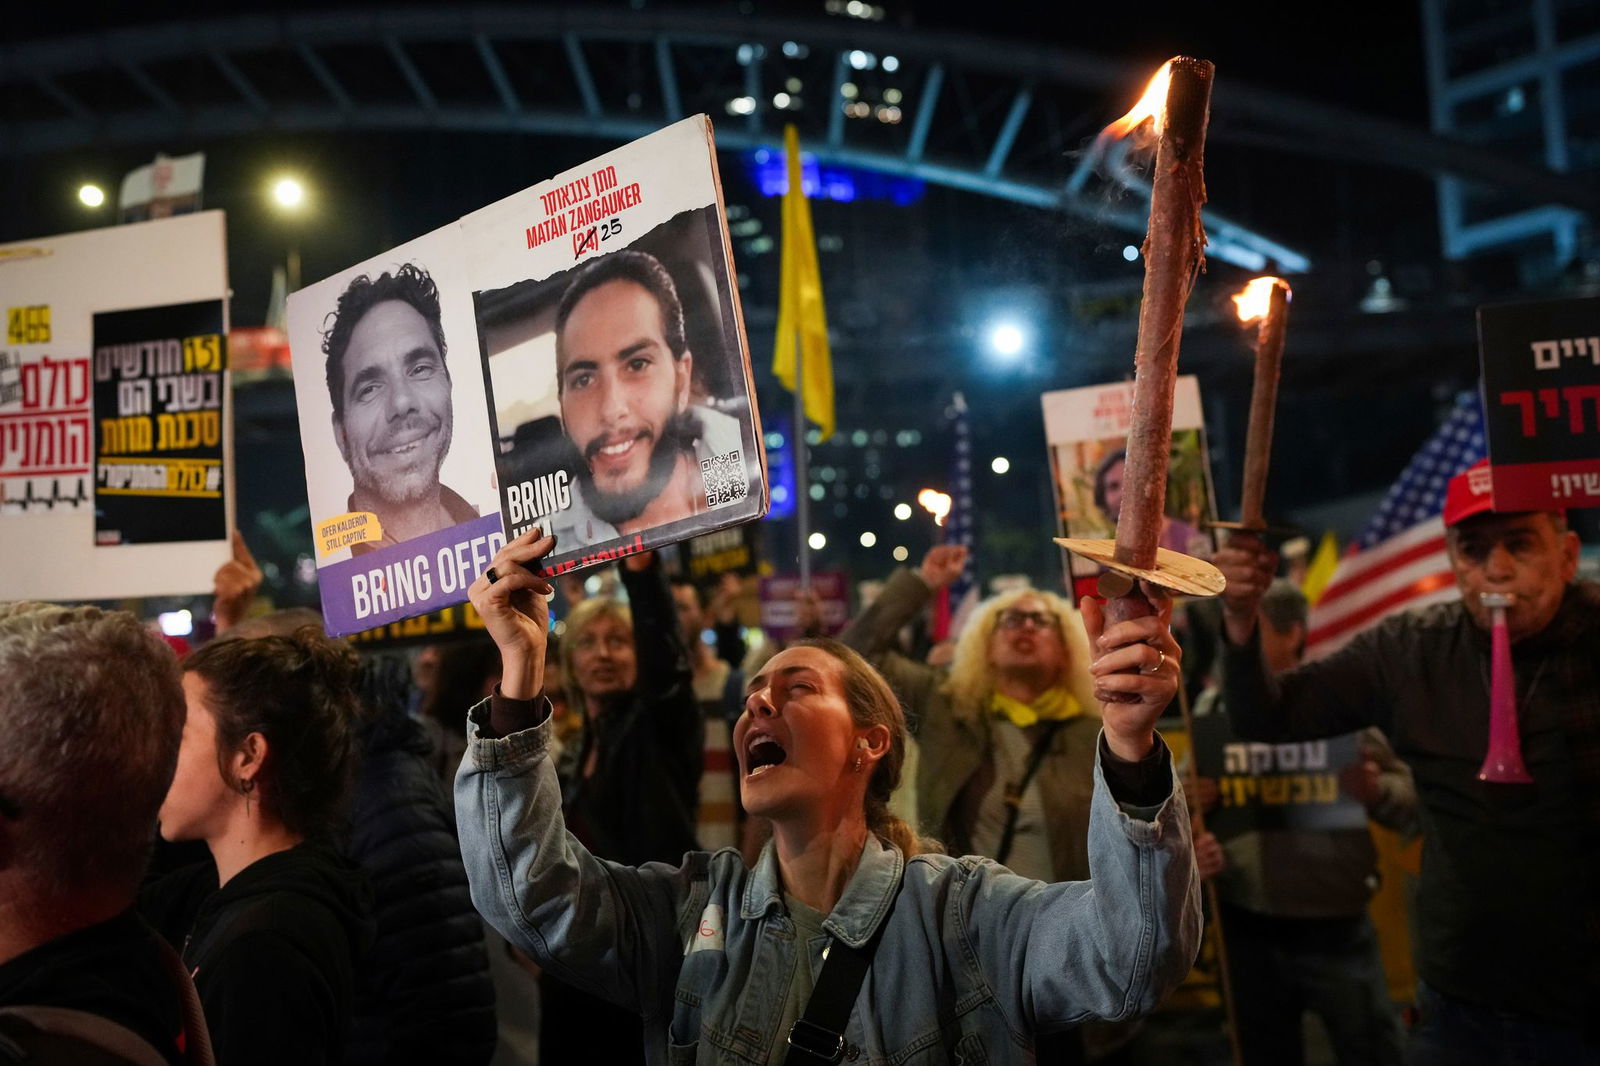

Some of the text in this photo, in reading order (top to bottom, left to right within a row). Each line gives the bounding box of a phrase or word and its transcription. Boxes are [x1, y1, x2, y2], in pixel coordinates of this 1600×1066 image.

[539, 165, 618, 216] מתן צננאוקר
[526, 182, 642, 250] MATAN ZANGAUKER
[601, 218, 622, 242] 25
[21, 356, 90, 408] כולם
[95, 339, 182, 381] חודשים
[118, 379, 152, 416] הם
[0, 418, 90, 468] הומני
[100, 411, 220, 456] סכנת מוות
[507, 469, 571, 524] BRING
[321, 514, 368, 538] OFER KALDERON
[326, 528, 367, 551] STILL CAPTIVE
[352, 554, 432, 620] BRING
[1224, 741, 1329, 775] עסקה
